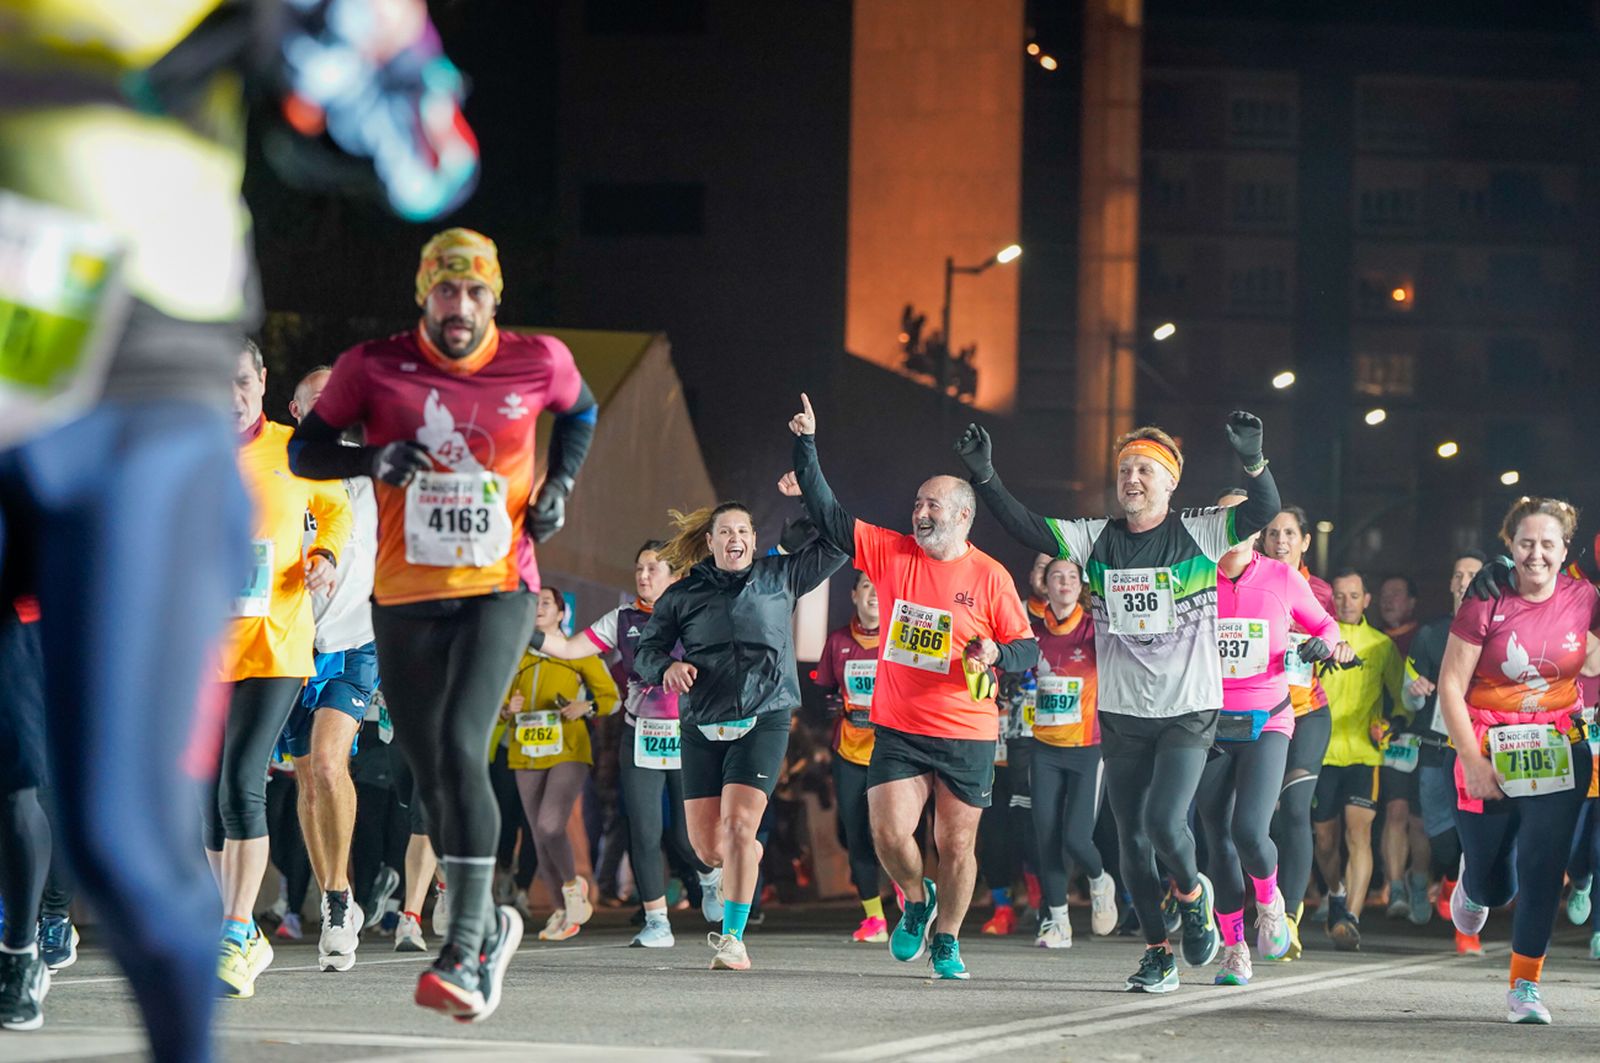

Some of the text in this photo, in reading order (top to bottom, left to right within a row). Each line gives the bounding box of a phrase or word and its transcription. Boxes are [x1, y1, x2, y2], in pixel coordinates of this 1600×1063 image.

[428, 508, 489, 533] 4163
[1112, 585, 1126, 593] SAN
[1123, 592, 1158, 612] 336
[900, 623, 944, 651] 5666
[1218, 640, 1249, 658] 337
[1040, 694, 1075, 710] 12597
[1530, 731, 1540, 739] DE
[1499, 742, 1514, 752] SAN
[1507, 749, 1556, 772] 7503
